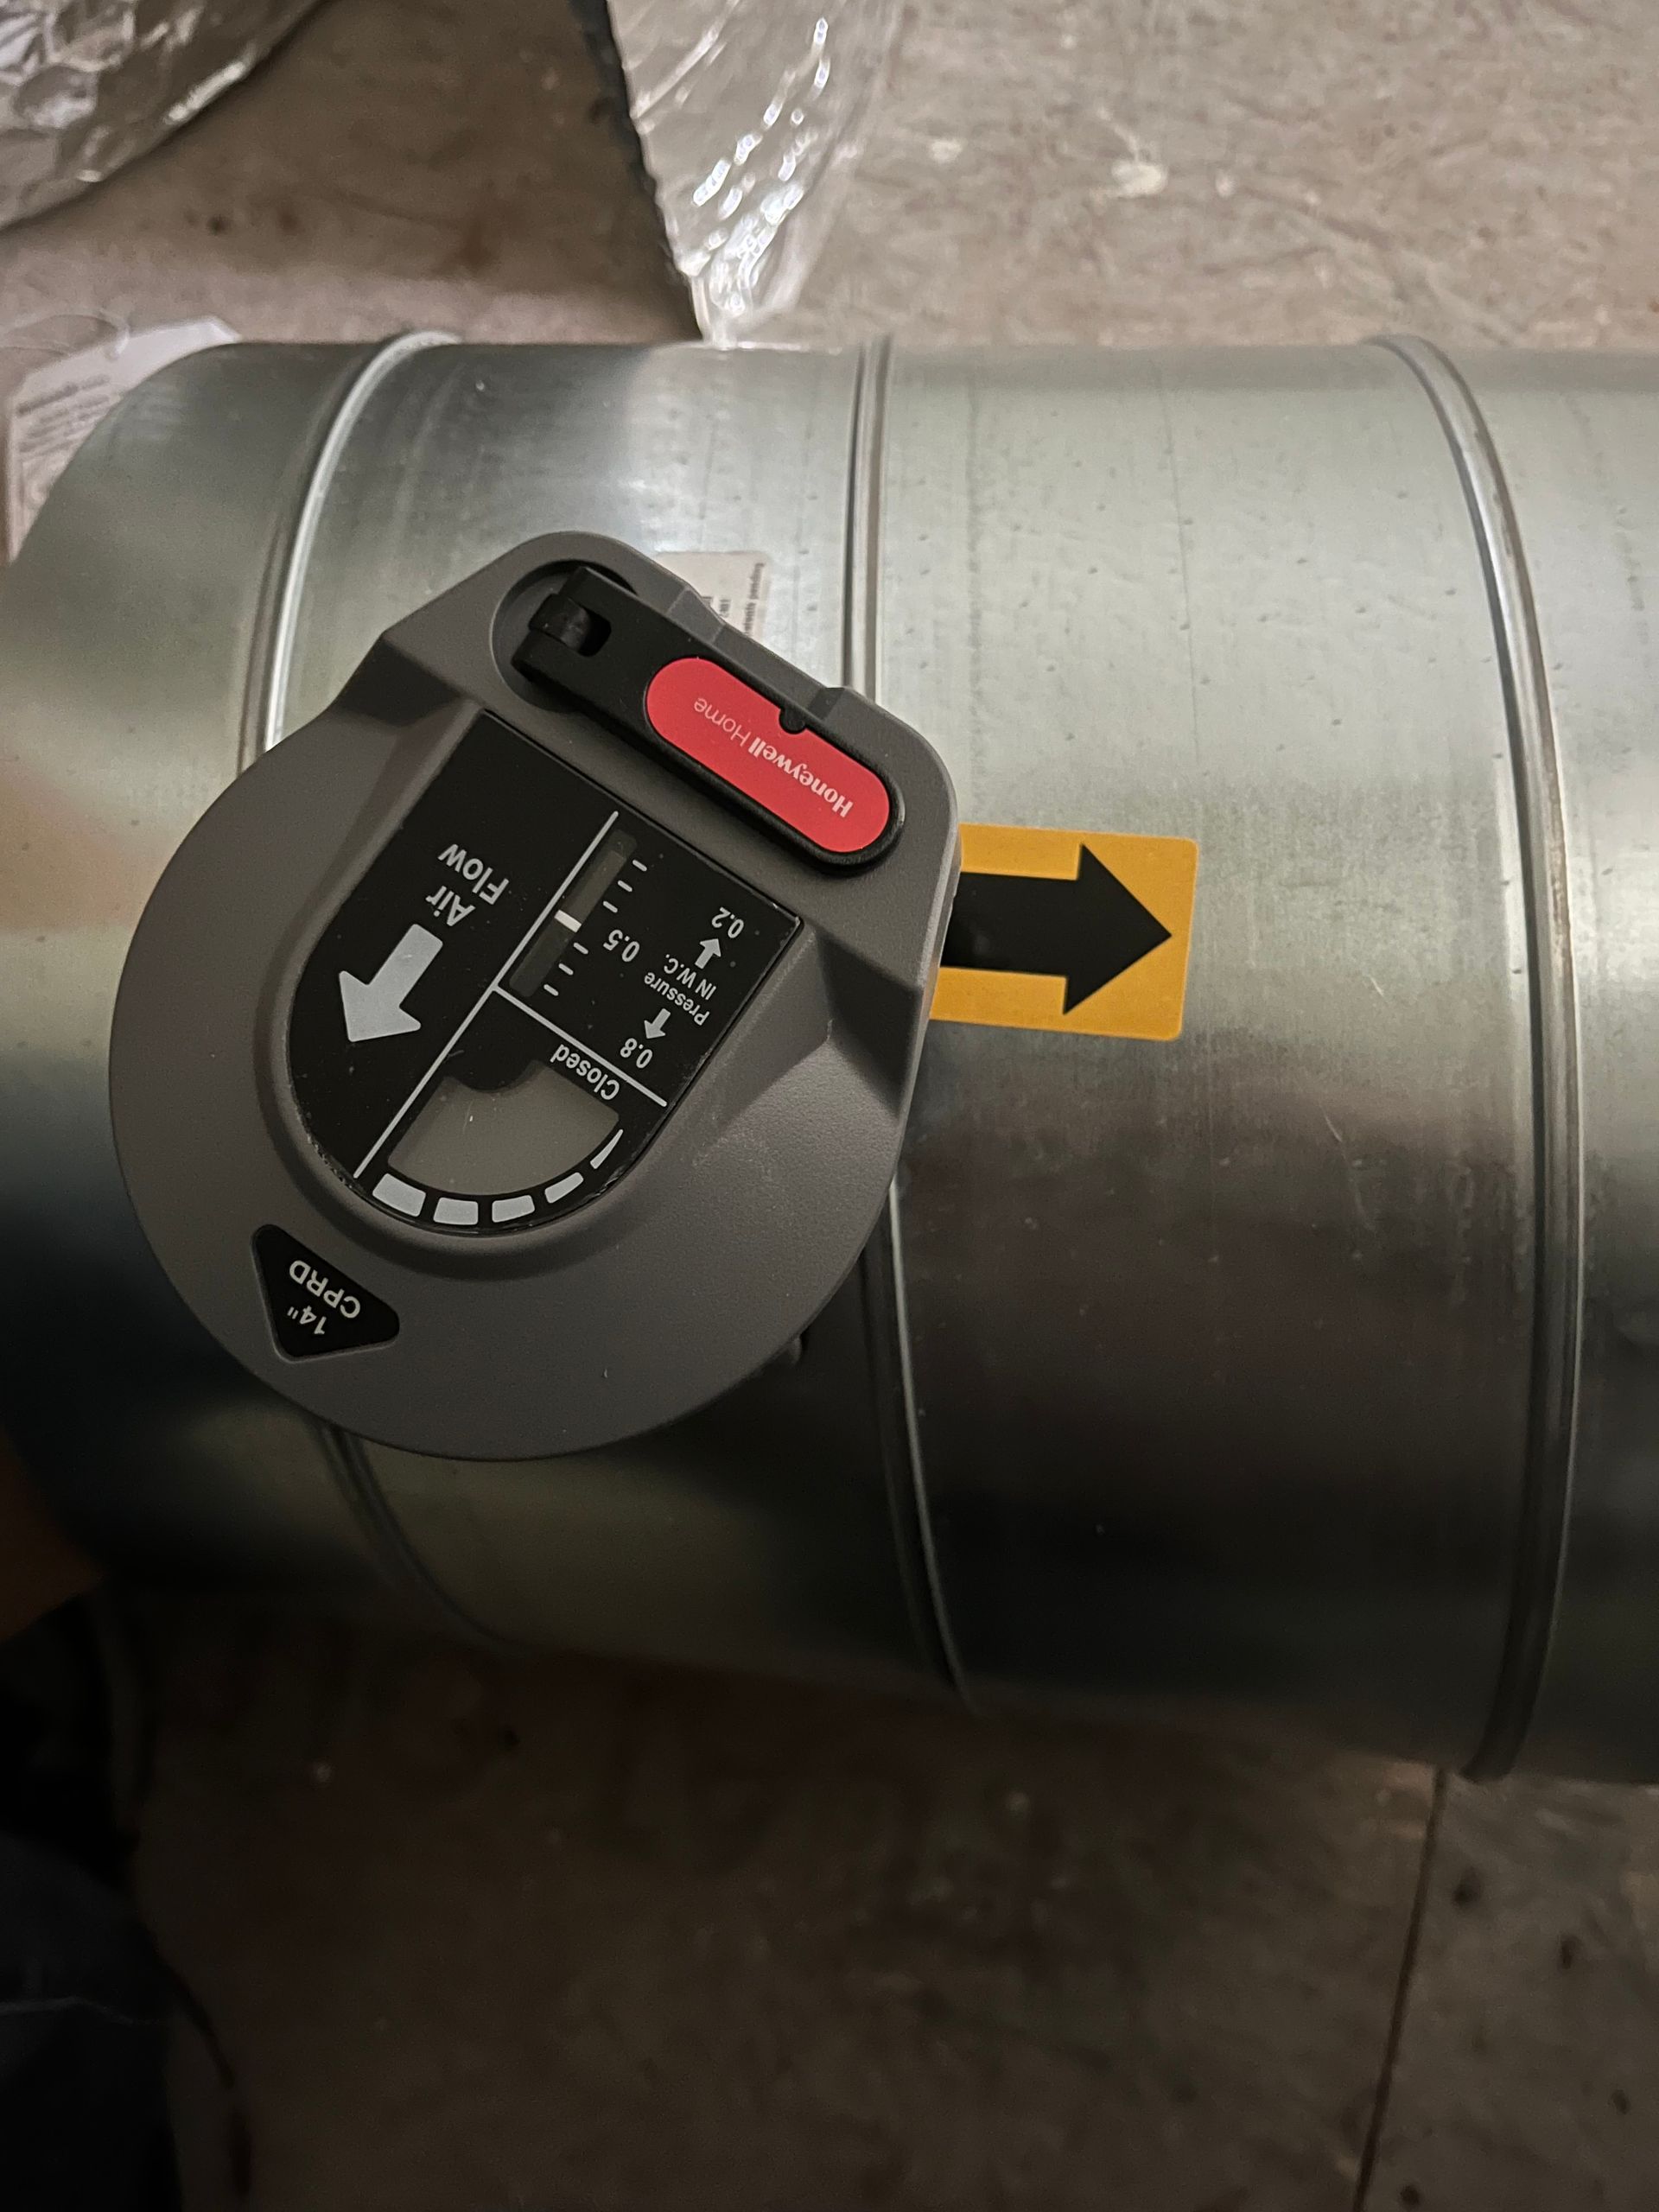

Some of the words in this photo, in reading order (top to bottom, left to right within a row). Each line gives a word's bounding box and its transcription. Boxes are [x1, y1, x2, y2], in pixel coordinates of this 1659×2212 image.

[694, 697, 751, 747] Home
[747, 737, 854, 818] Honeywell
[437, 843, 510, 905] Flow
[425, 885, 476, 926] Air
[711, 906, 744, 938] 0.2
[603, 929, 640, 963] 0.5
[664, 954, 697, 988] W.C.
[695, 978, 717, 1001] IN
[644, 972, 709, 1026] Pressure
[550, 1044, 620, 1101] Closed
[620, 1038, 653, 1069] 0.8
[289, 1260, 361, 1319] CPRD
[287, 1305, 327, 1335] 14"
